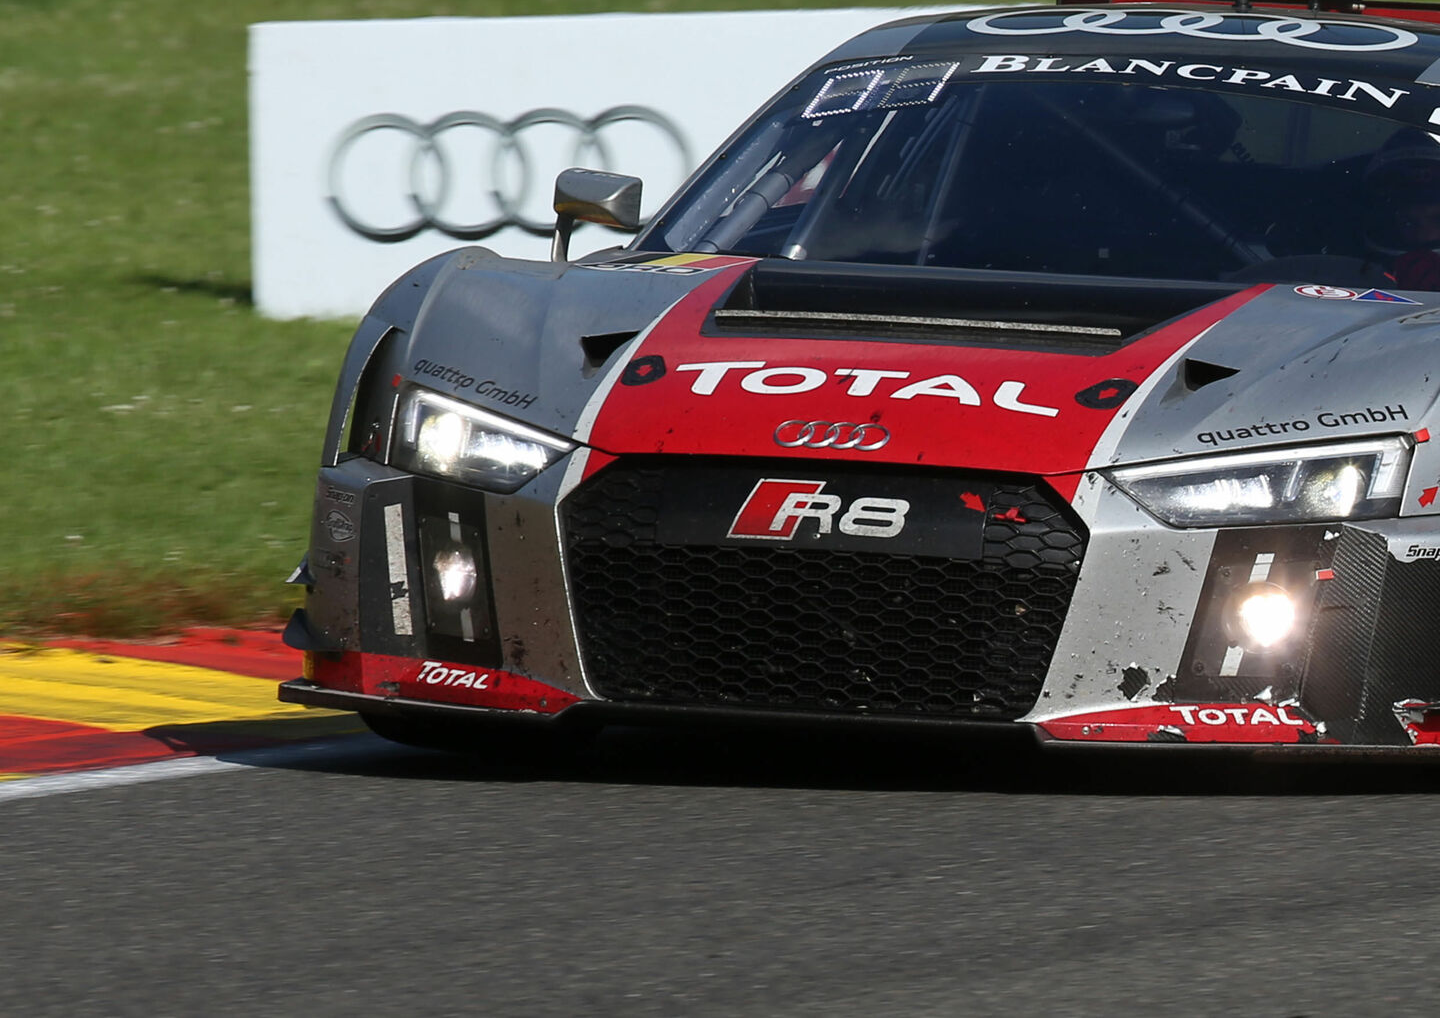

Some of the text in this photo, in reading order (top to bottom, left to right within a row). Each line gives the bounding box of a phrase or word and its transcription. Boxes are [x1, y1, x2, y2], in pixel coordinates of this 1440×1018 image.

[824, 56, 914, 74] POSITION
[970, 55, 1410, 109] BLANCPAIN
[414, 359, 538, 410] quattro GmbH
[676, 361, 1060, 418] TOTAL
[1197, 404, 1409, 446] quattro GmbH
[766, 491, 911, 539] R8
[416, 661, 489, 690] TOTAL
[1169, 705, 1304, 726] TOTAL
